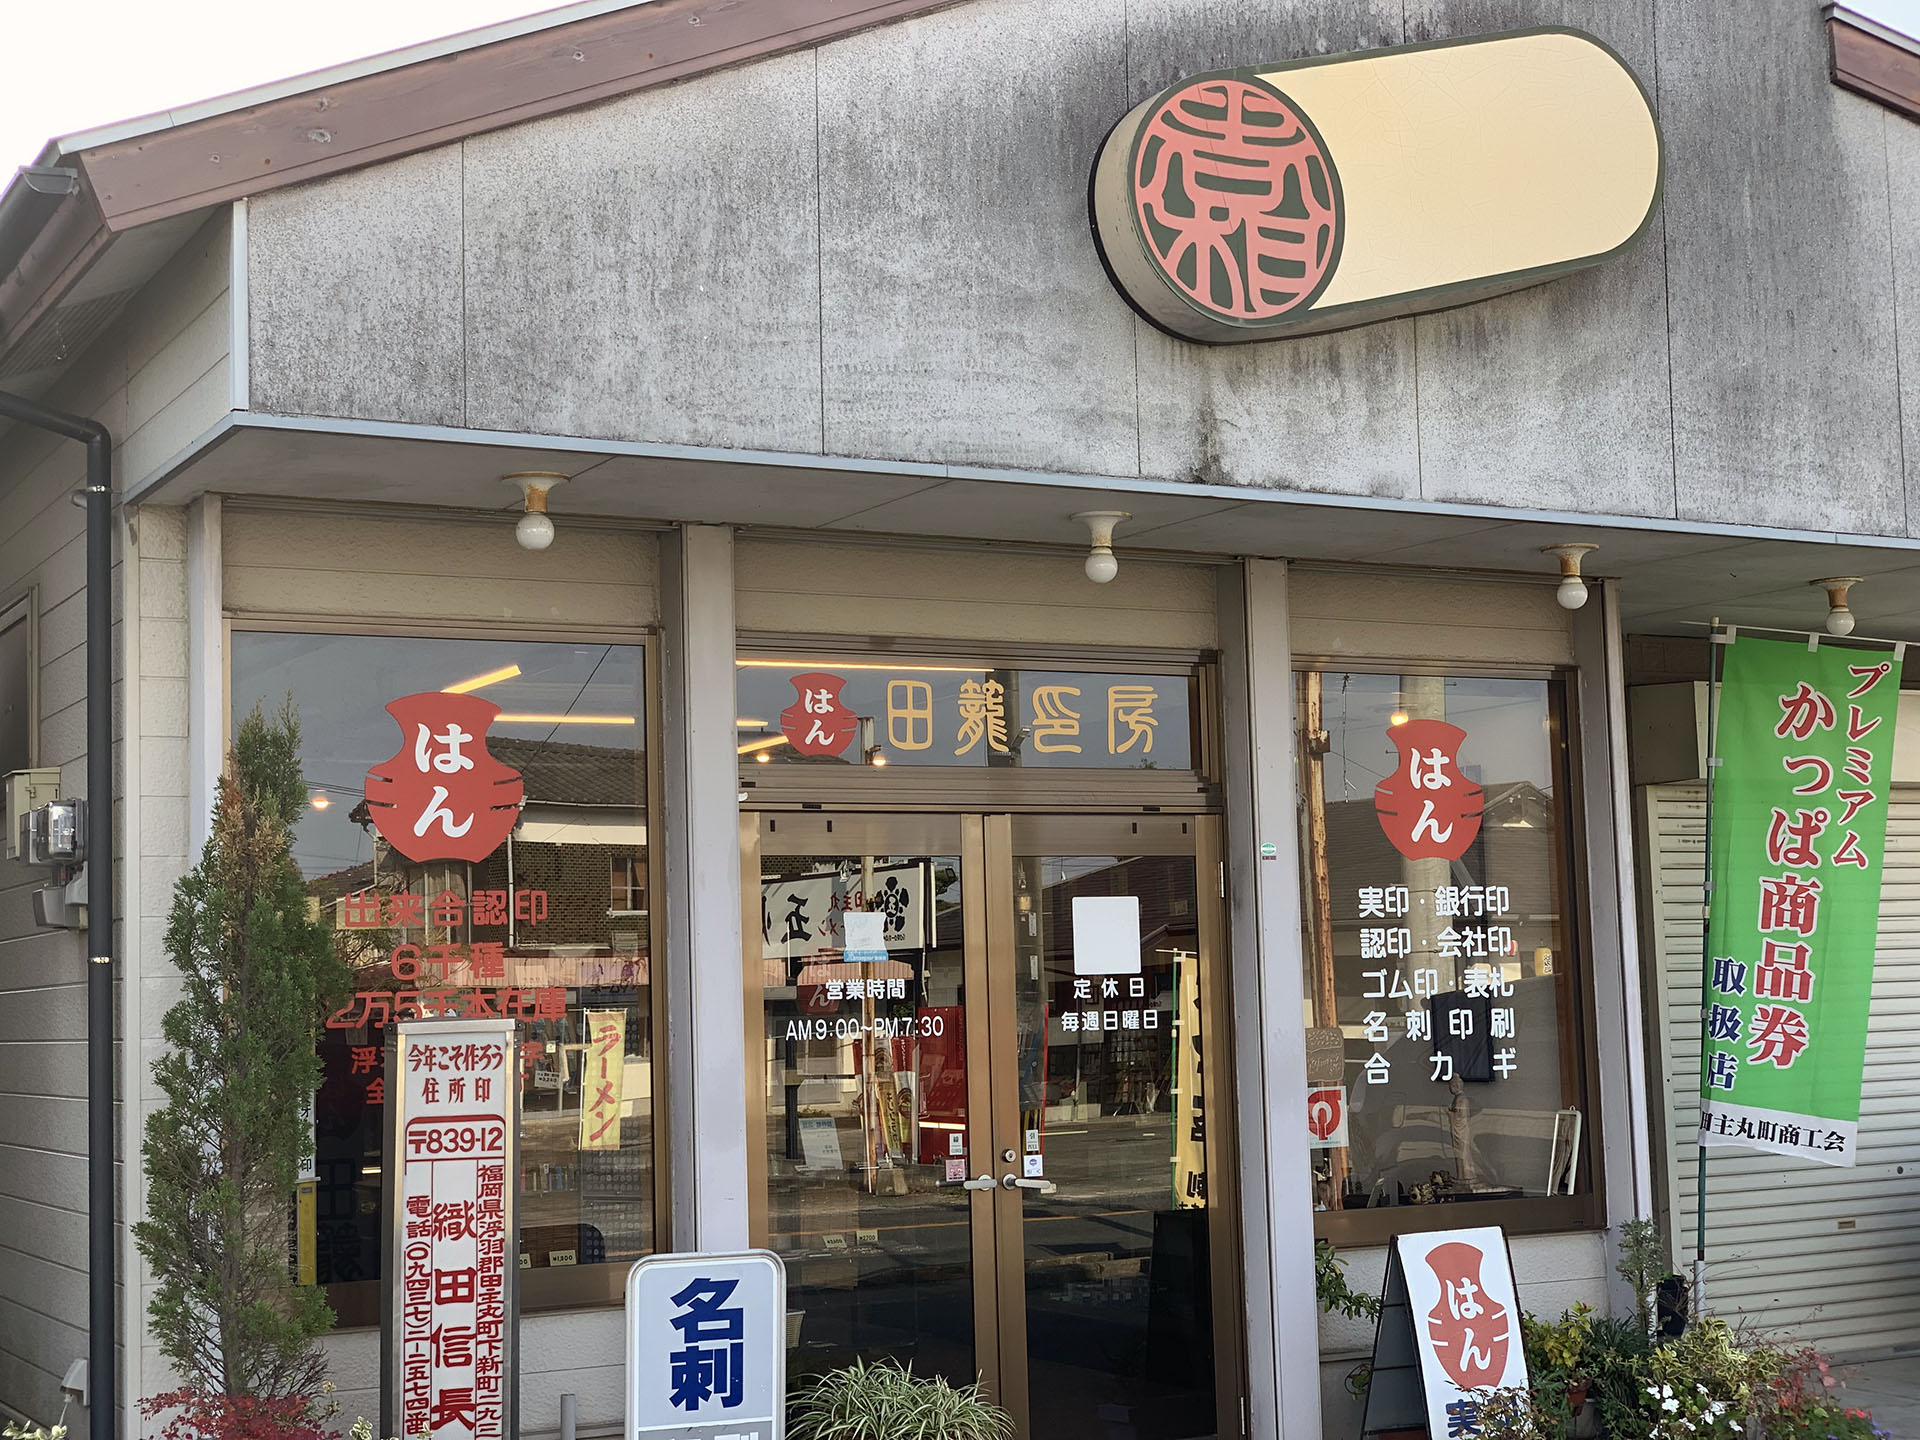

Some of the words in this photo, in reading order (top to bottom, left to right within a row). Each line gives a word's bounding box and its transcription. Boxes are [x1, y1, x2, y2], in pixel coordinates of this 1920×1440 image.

[805, 688, 835, 746] はん
[413, 723, 474, 838] はん
[1832, 662, 1891, 869] プレミアム
[1410, 747, 1453, 843] はん
[344, 889, 549, 927] 出来合認印
[391, 941, 505, 980] 6千種
[825, 978, 906, 1000] 営業時間
[1073, 977, 1144, 999] 定休日
[1061, 1009, 1158, 1032] 毎週日曜日
[1362, 1007, 1516, 1043] 名刺印刷
[1706, 957, 1747, 1091] 取扱店
[408, 1043, 504, 1073] 今年こそ作ろう
[1364, 1047, 1518, 1085] 合カギ
[421, 1077, 492, 1105] 住所印
[589, 1024, 621, 1142] ラーメン
[430, 1199, 478, 1431] 織田信長
[1445, 1277, 1492, 1372] はん
[669, 1278, 744, 1412] 名刺
